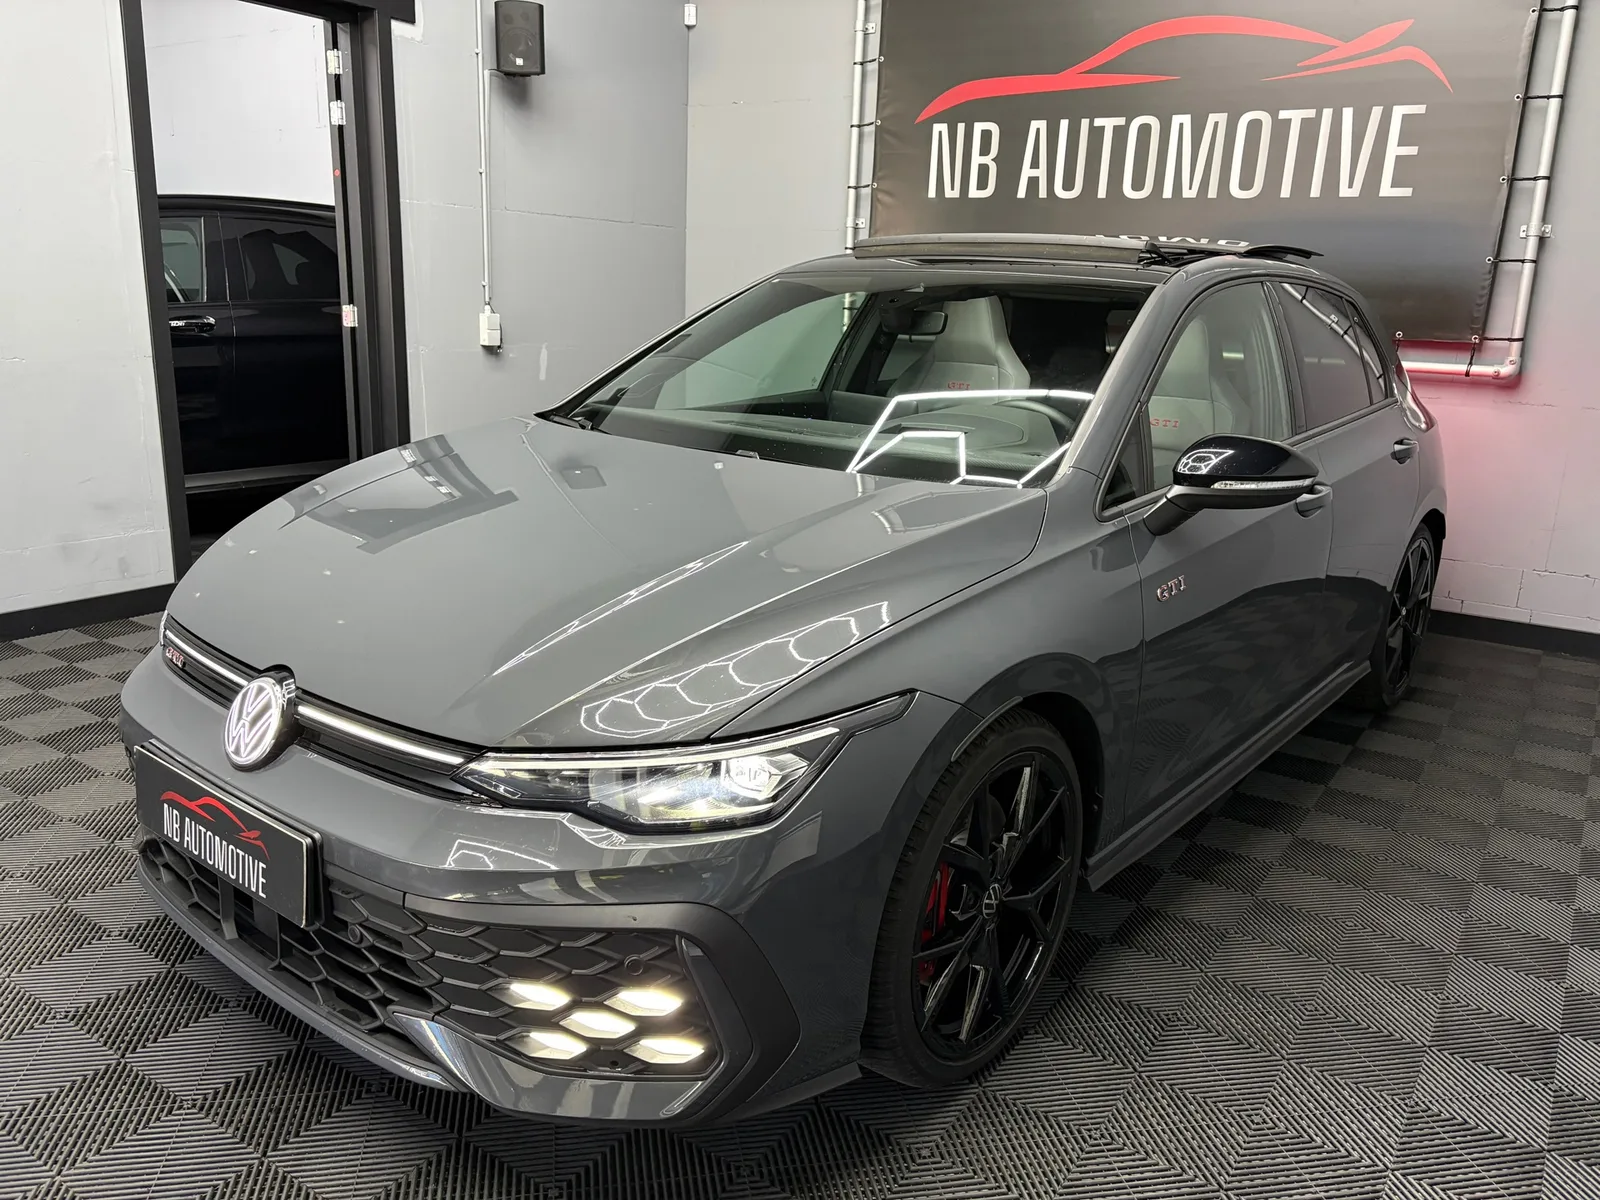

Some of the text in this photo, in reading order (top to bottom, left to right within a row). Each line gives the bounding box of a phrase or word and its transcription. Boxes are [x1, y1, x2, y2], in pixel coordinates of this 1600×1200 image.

[927, 104, 1427, 199] NB AUTOMOTIVE
[1149, 418, 1179, 428] GTI
[1157, 575, 1186, 602] GTI
[225, 679, 279, 763] VW
[163, 803, 267, 899] NB AUTOMOTIVE
